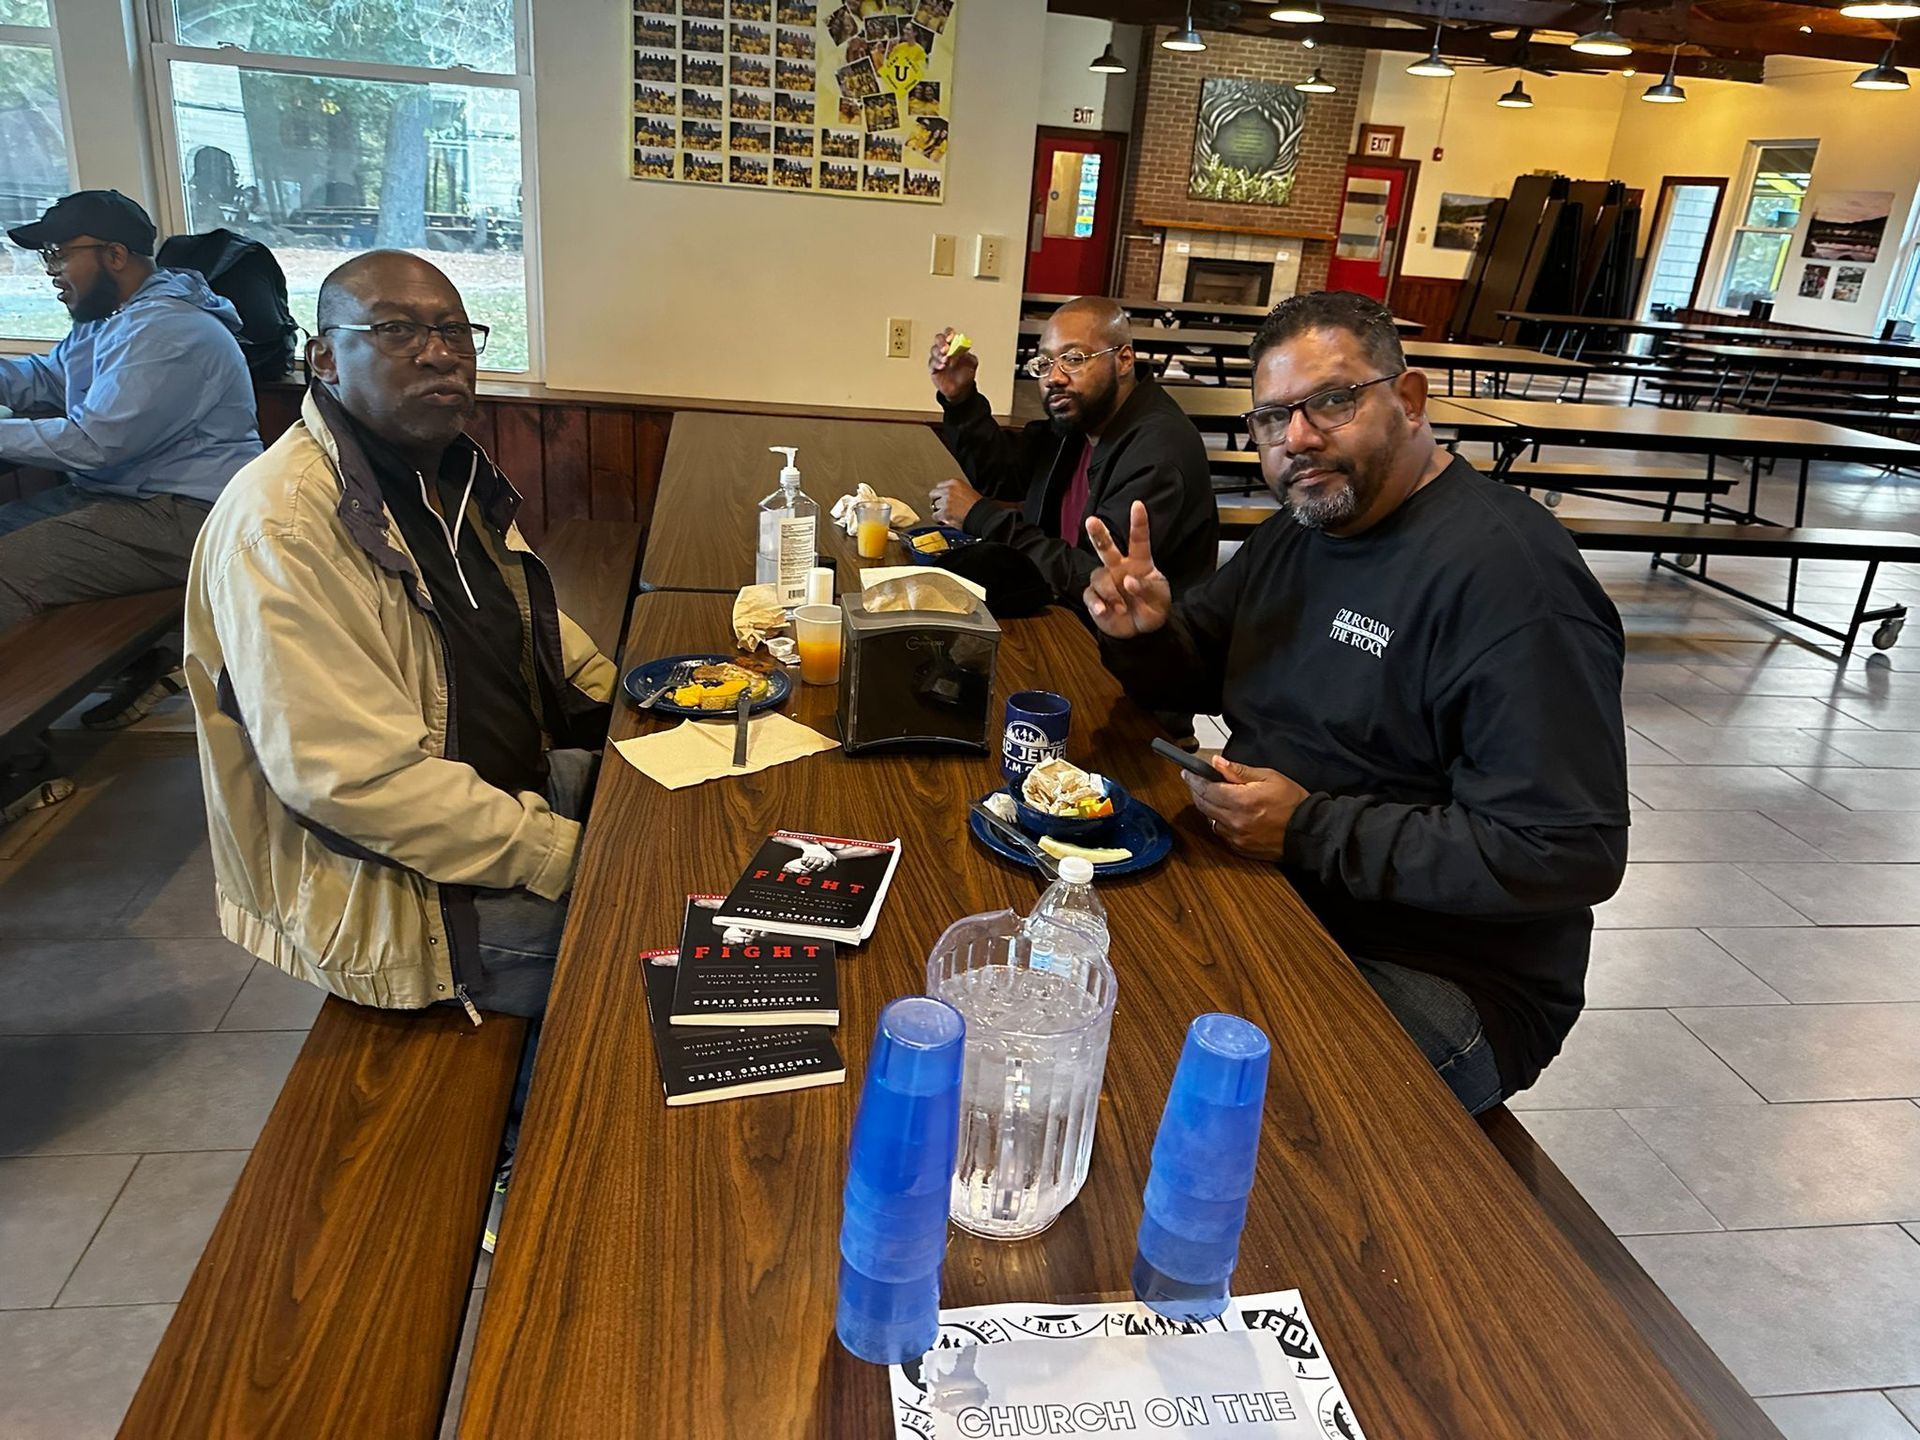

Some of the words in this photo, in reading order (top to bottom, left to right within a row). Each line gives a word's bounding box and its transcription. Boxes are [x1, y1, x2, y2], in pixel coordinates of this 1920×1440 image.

[894, 65, 909, 82] U
[1073, 108, 1094, 124] EXIT
[1371, 137, 1391, 152] EXIT
[1336, 608, 1379, 634] CHURCH
[1378, 623, 1396, 641] ON
[1329, 626, 1352, 644] THE
[753, 870, 865, 894] FIGHT
[736, 906, 772, 916] CRAIG
[778, 912, 846, 924] GROESCHEL
[694, 946, 820, 958] FIGHT
[694, 998, 734, 1006] CRAIG
[742, 996, 820, 1004] GROESCHEL
[683, 1040, 732, 1050] WINNING
[738, 1036, 758, 1044] THE
[764, 1030, 809, 1040] BATTLES
[727, 1043, 768, 1054] MATTER
[774, 1038, 804, 1046] MOST
[688, 1069, 733, 1083] CRAIG
[740, 1057, 822, 1074] GROESCHEL
[1022, 1316, 1082, 1334] YMCA
[1251, 1310, 1313, 1354] 1901
[956, 1400, 1136, 1439] CHURCH
[1144, 1396, 1210, 1428] ON
[1212, 1392, 1296, 1424] THE
